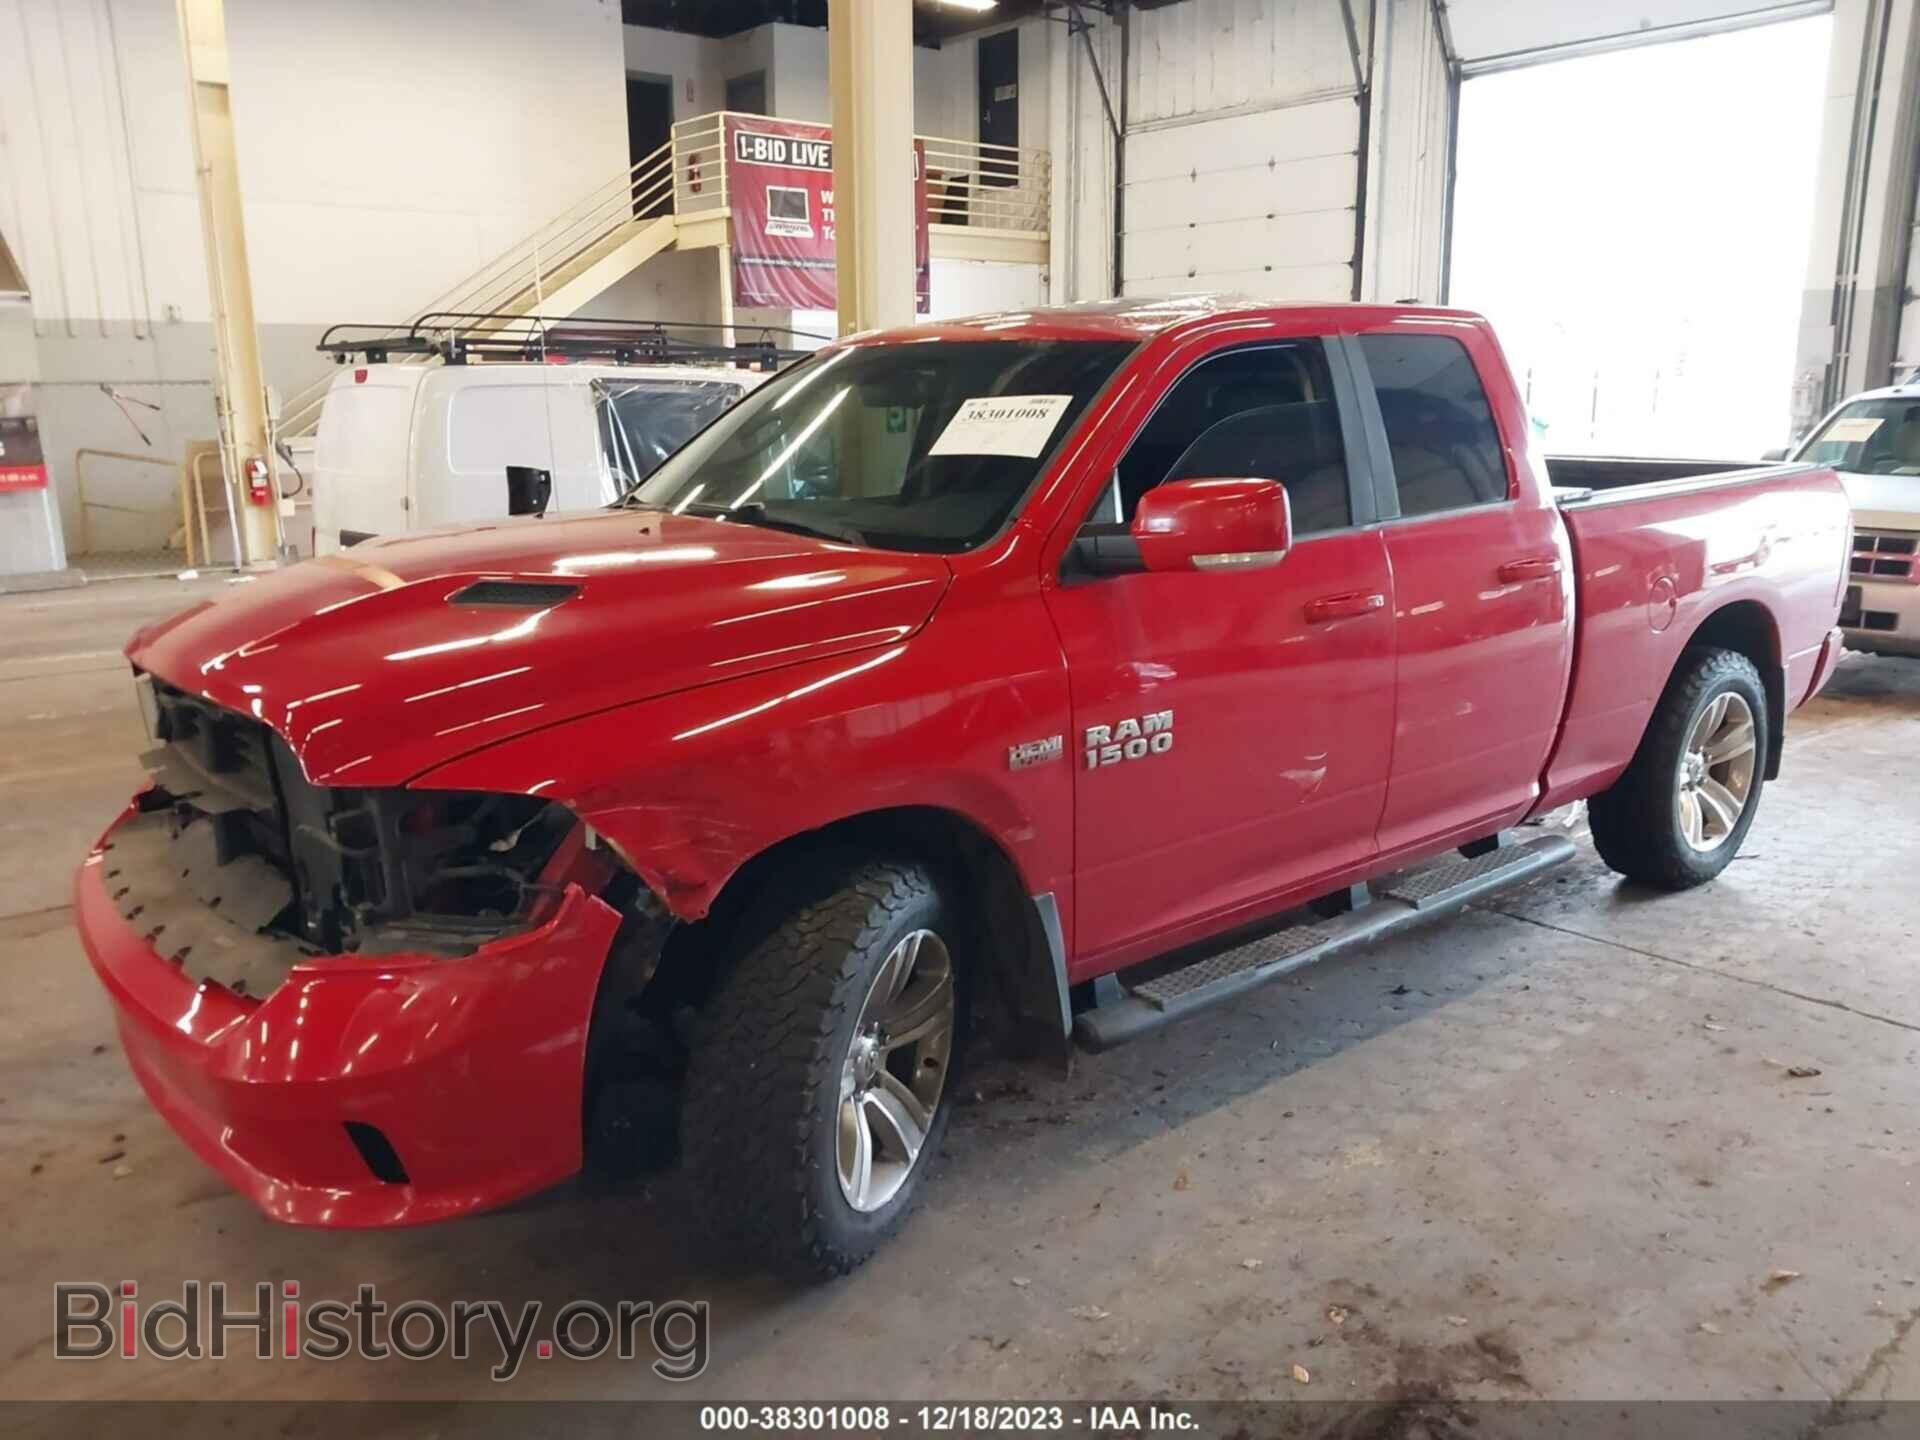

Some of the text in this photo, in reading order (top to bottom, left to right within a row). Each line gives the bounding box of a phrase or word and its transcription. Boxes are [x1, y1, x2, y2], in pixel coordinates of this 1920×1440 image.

[740, 135, 830, 167] I-BID LIVE
[1085, 709, 1174, 748] RAM
[1085, 732, 1173, 770] 1500
